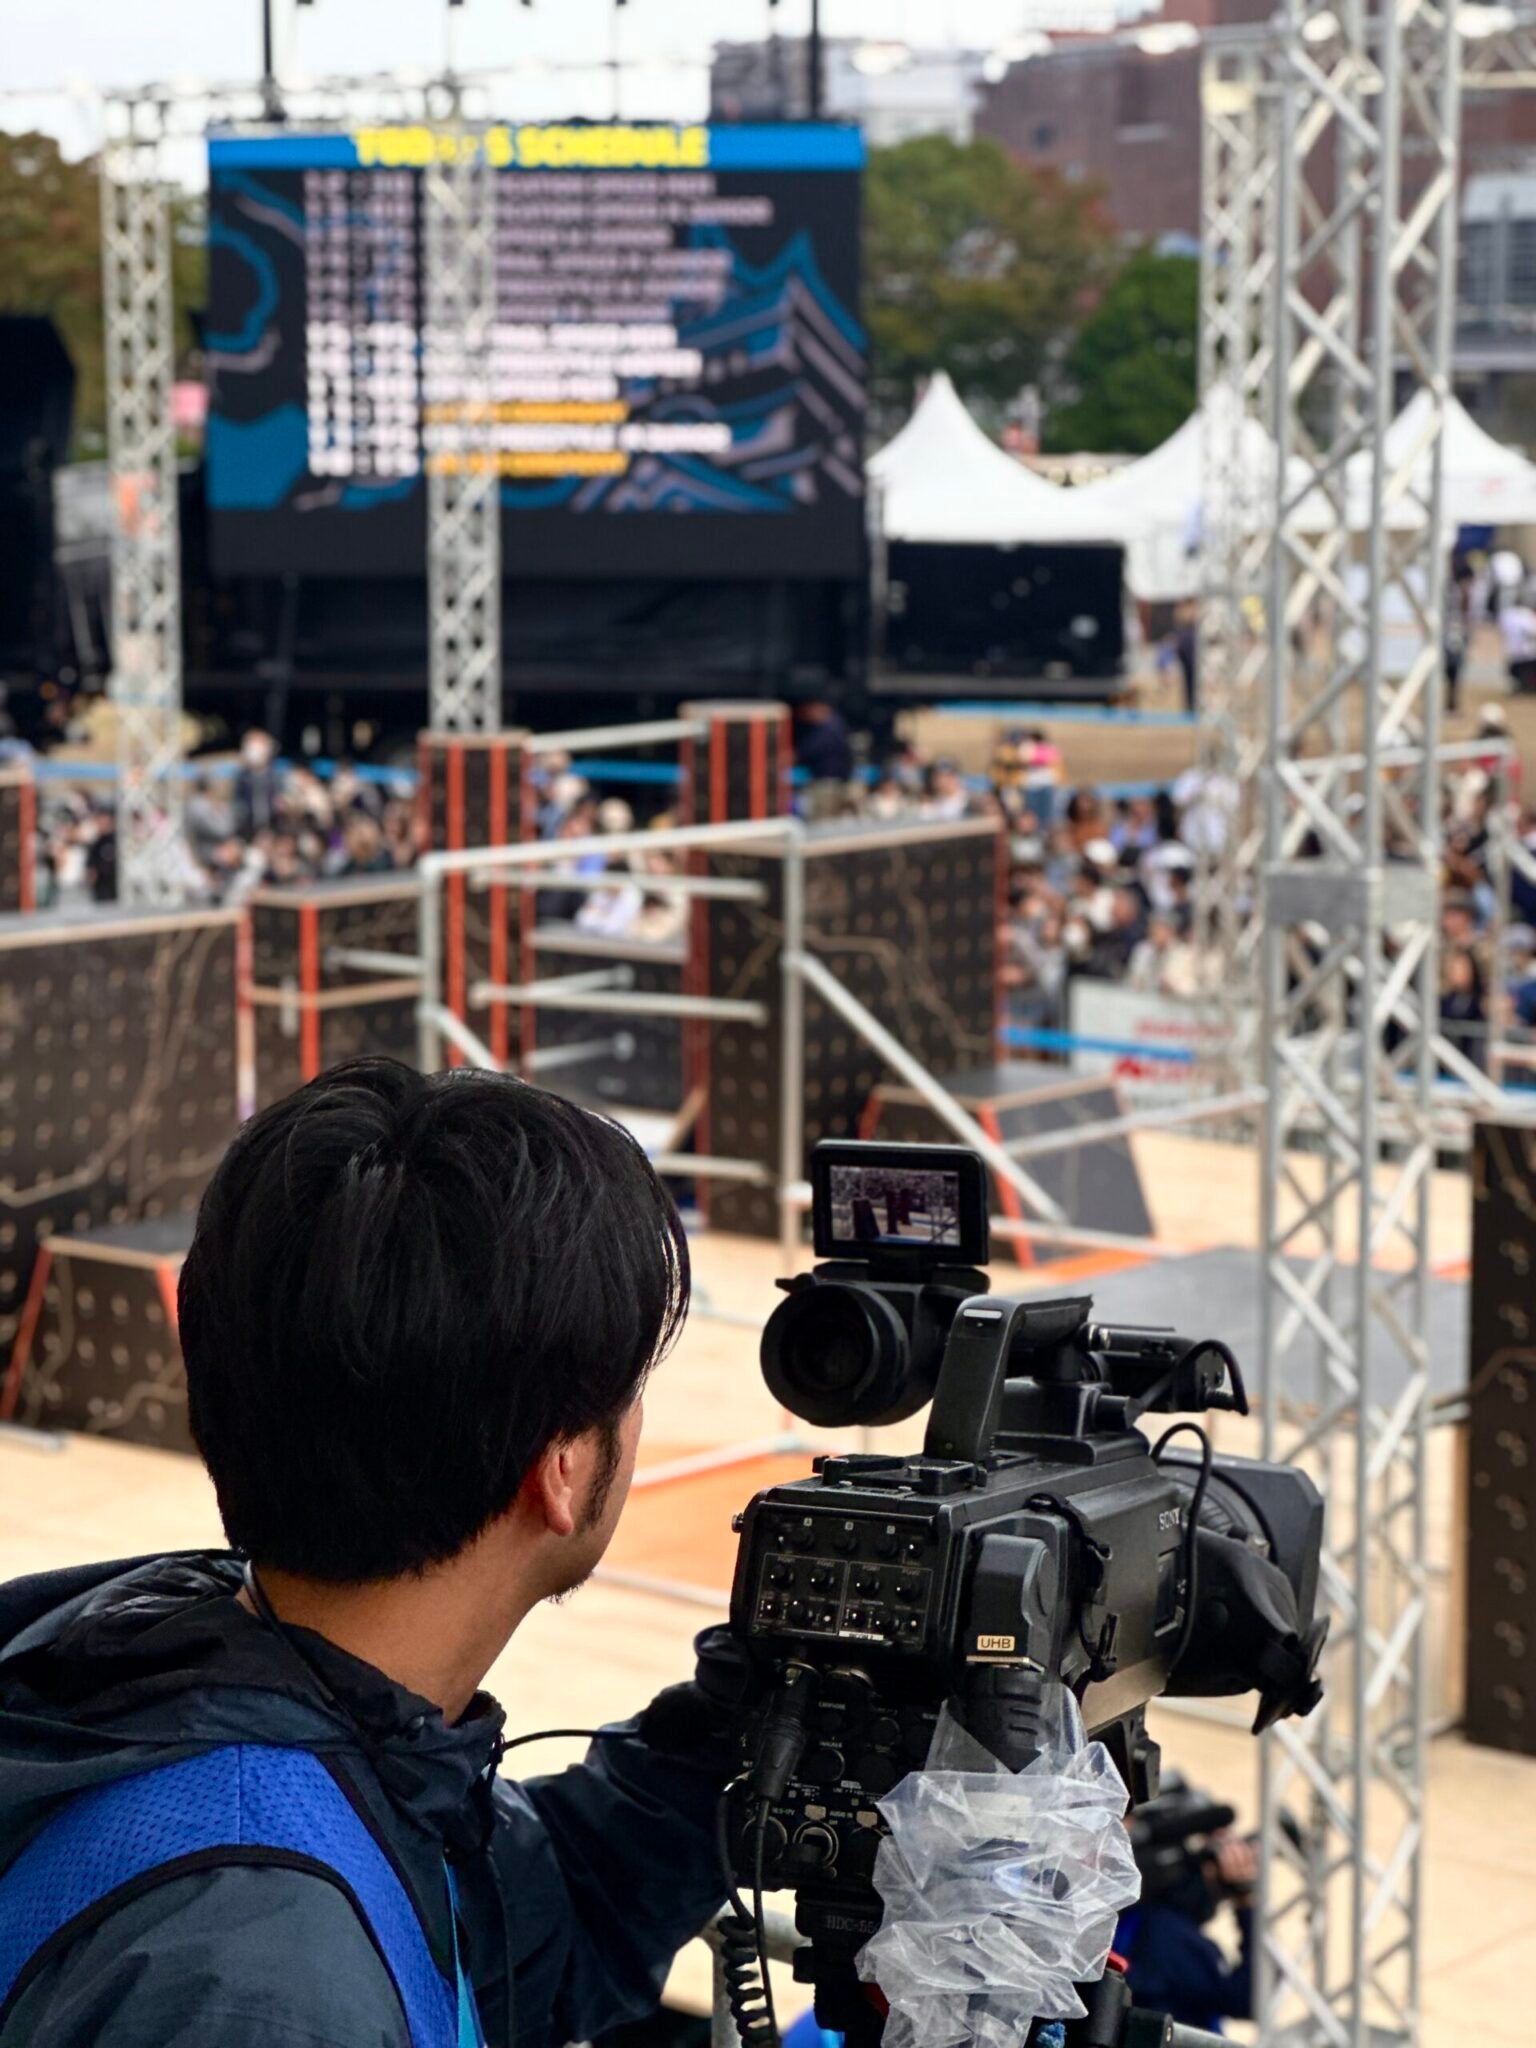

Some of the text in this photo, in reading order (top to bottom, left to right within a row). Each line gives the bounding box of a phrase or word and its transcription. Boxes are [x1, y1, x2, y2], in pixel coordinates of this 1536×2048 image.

[356, 126, 512, 168] TODS
[1159, 1507, 1180, 1530] SONY
[981, 1638, 1011, 1649] UHB
